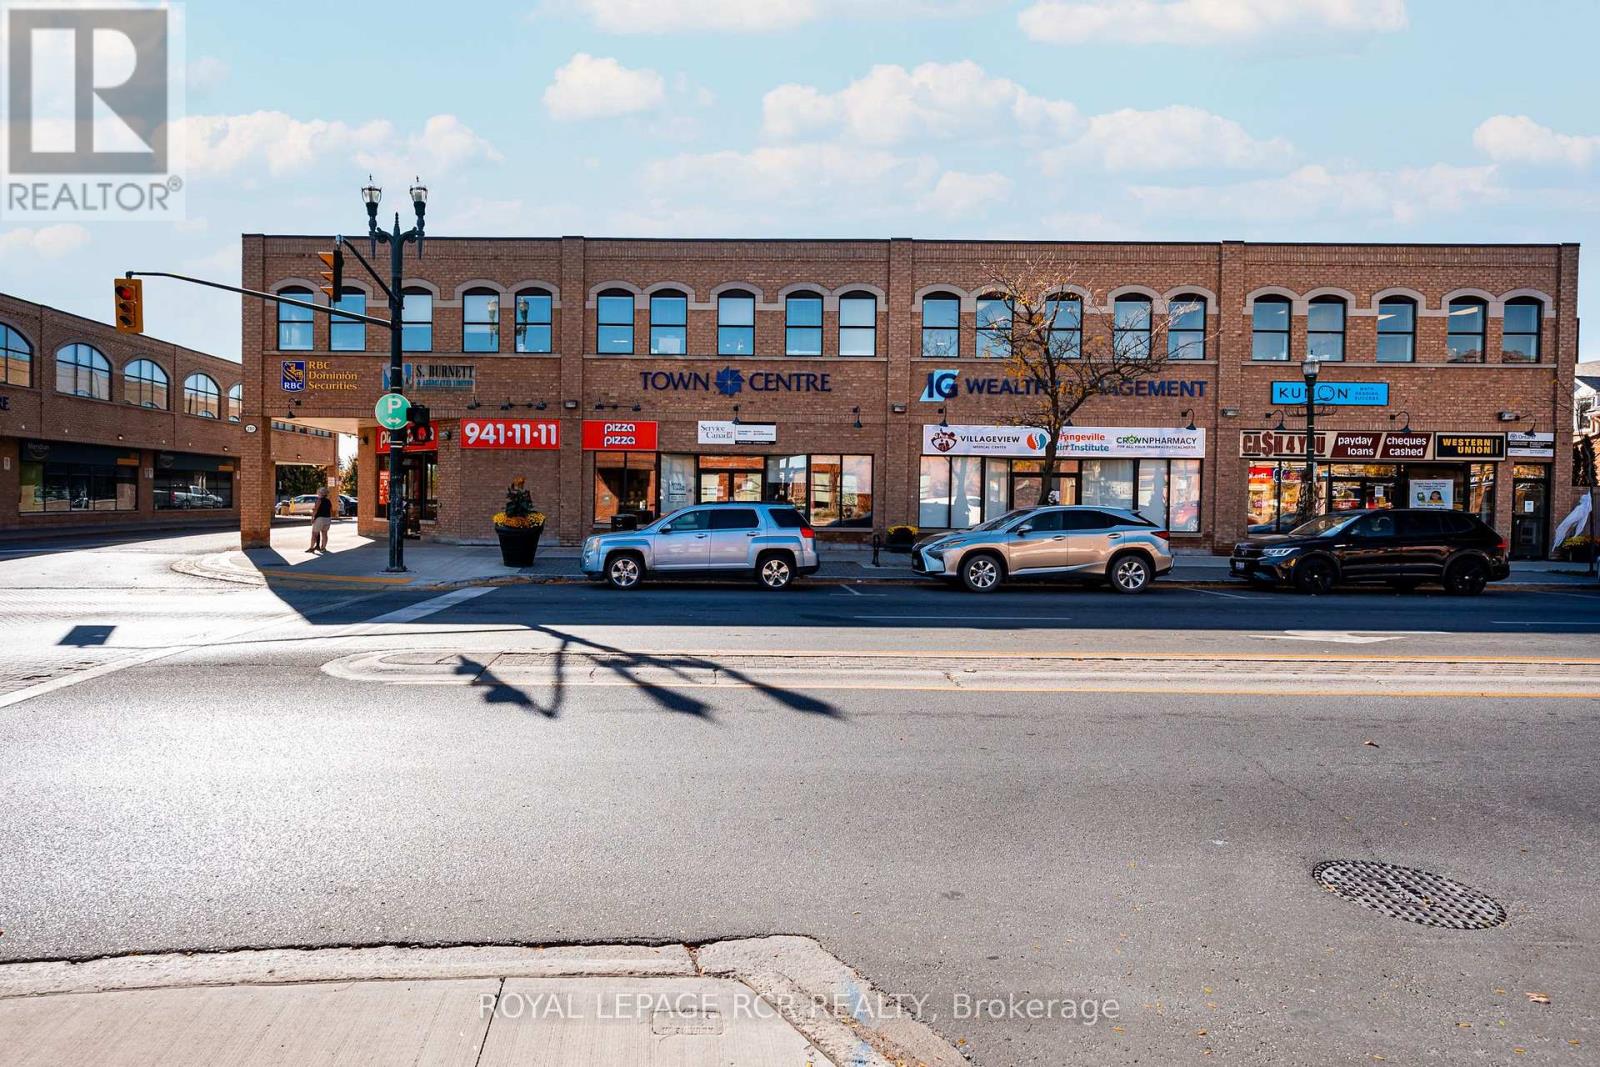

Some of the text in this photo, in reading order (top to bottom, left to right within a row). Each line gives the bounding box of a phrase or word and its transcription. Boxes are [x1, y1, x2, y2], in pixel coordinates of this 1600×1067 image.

[308, 361, 330, 370] RBC
[308, 371, 358, 380] Dominion
[416, 364, 474, 378] S. BURNETT
[308, 381, 358, 390] Securities
[640, 371, 832, 392] TOWN CENTRE
[928, 373, 958, 399] IG
[388, 398, 402, 414] P
[604, 423, 636, 434] pizza
[604, 436, 636, 447] pizza
[960, 435, 1020, 443] VILLAGEVIEW
[1338, 436, 1373, 446] payday
[1387, 436, 1427, 446] cheques
[1442, 438, 1491, 446] WESTERN
[1070, 444, 1110, 452] Institute
[1347, 446, 1374, 456] loans
[1389, 447, 1424, 456] cashed
[1457, 446, 1491, 454] UNION
